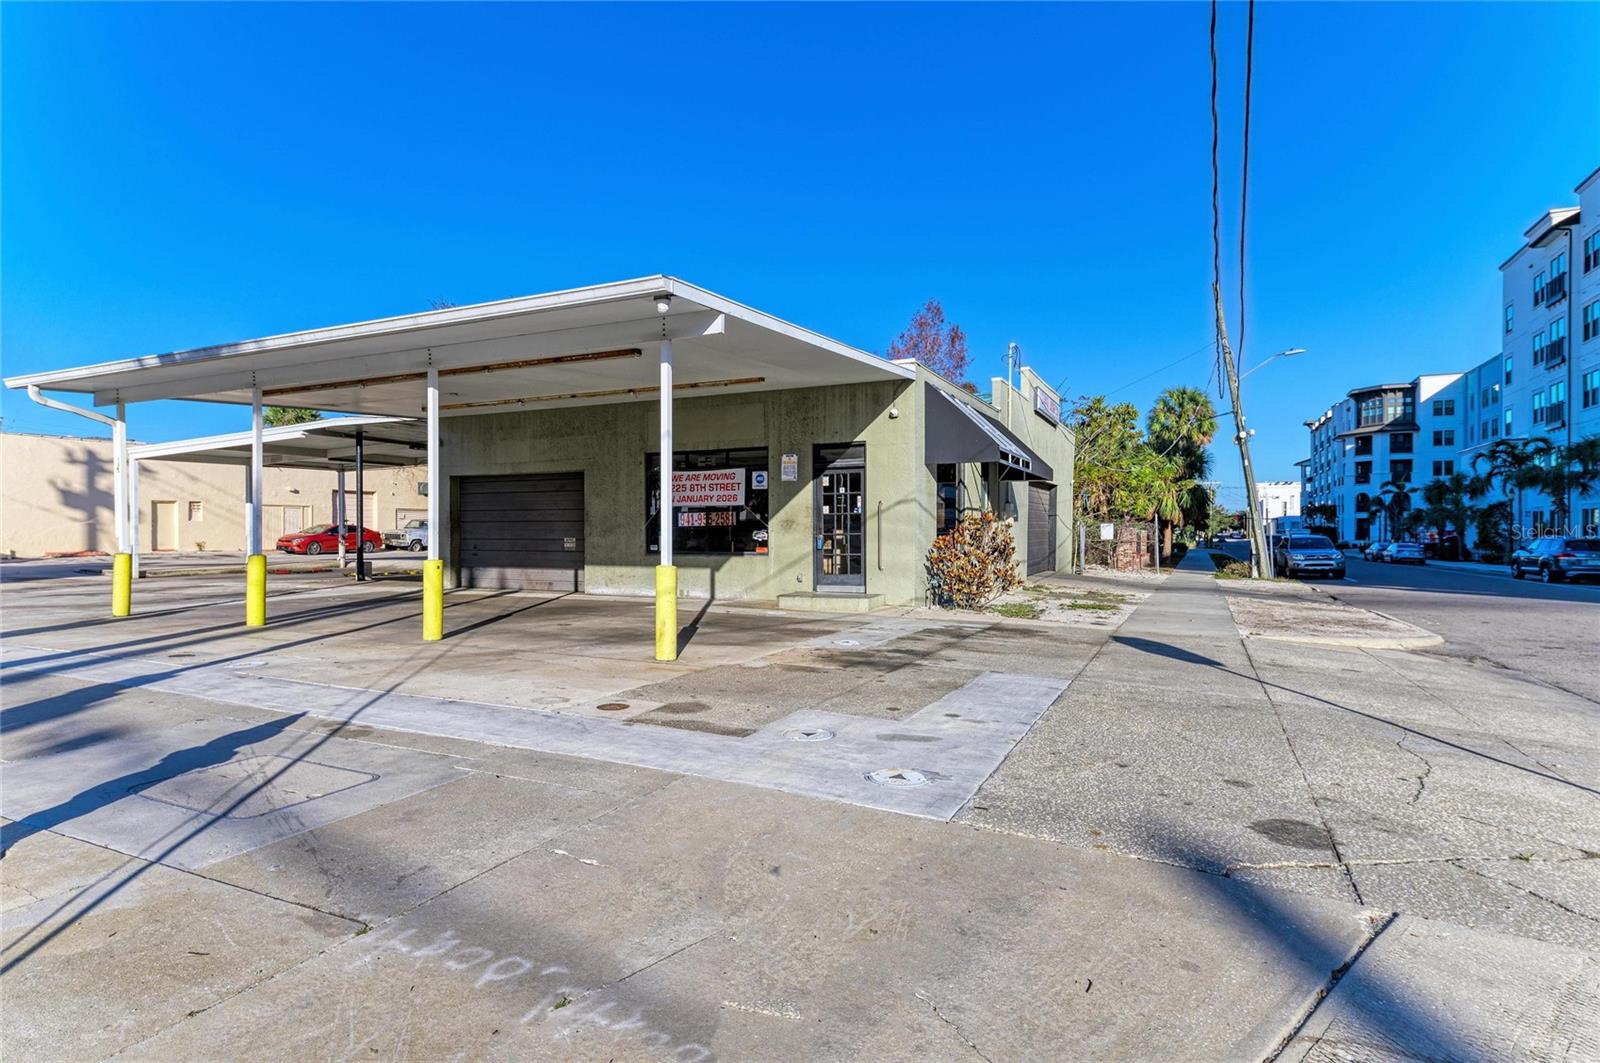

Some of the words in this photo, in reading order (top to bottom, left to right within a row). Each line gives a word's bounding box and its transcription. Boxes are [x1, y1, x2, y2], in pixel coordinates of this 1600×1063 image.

[685, 473, 701, 481] ARE
[703, 472, 736, 481] MOVING
[690, 483, 706, 492] 8TH
[709, 482, 742, 491] STREET
[676, 495, 715, 503] JANUARY
[716, 494, 738, 502] 2026
